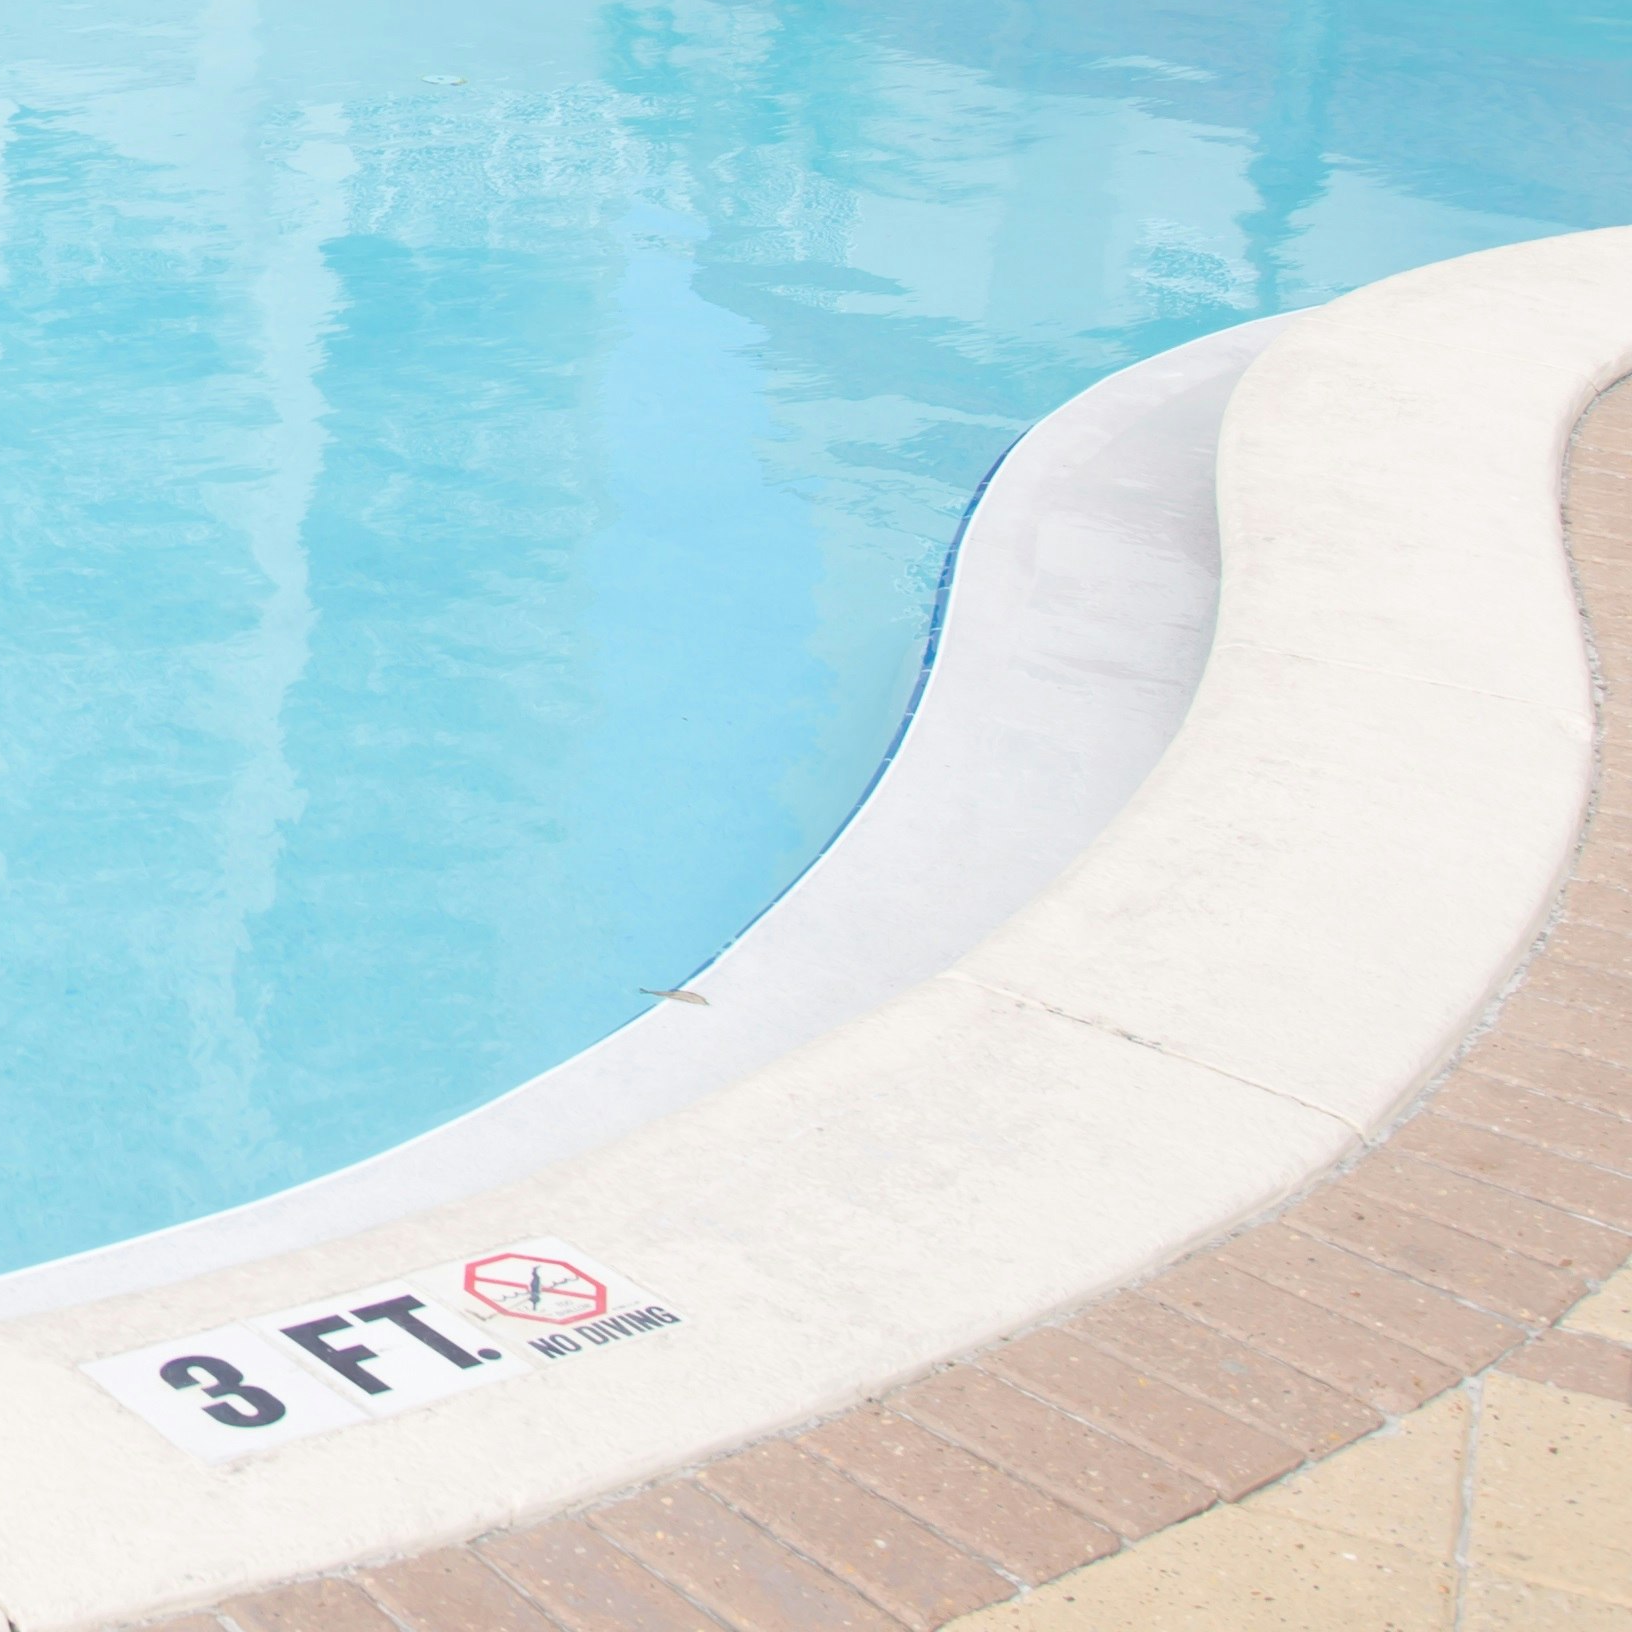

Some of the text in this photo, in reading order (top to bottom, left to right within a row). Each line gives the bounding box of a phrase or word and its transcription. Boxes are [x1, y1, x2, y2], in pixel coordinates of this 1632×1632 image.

[159, 1293, 503, 1428] 3 FT.
[528, 1333, 582, 1359] NO
[574, 1306, 682, 1346] DIVING
